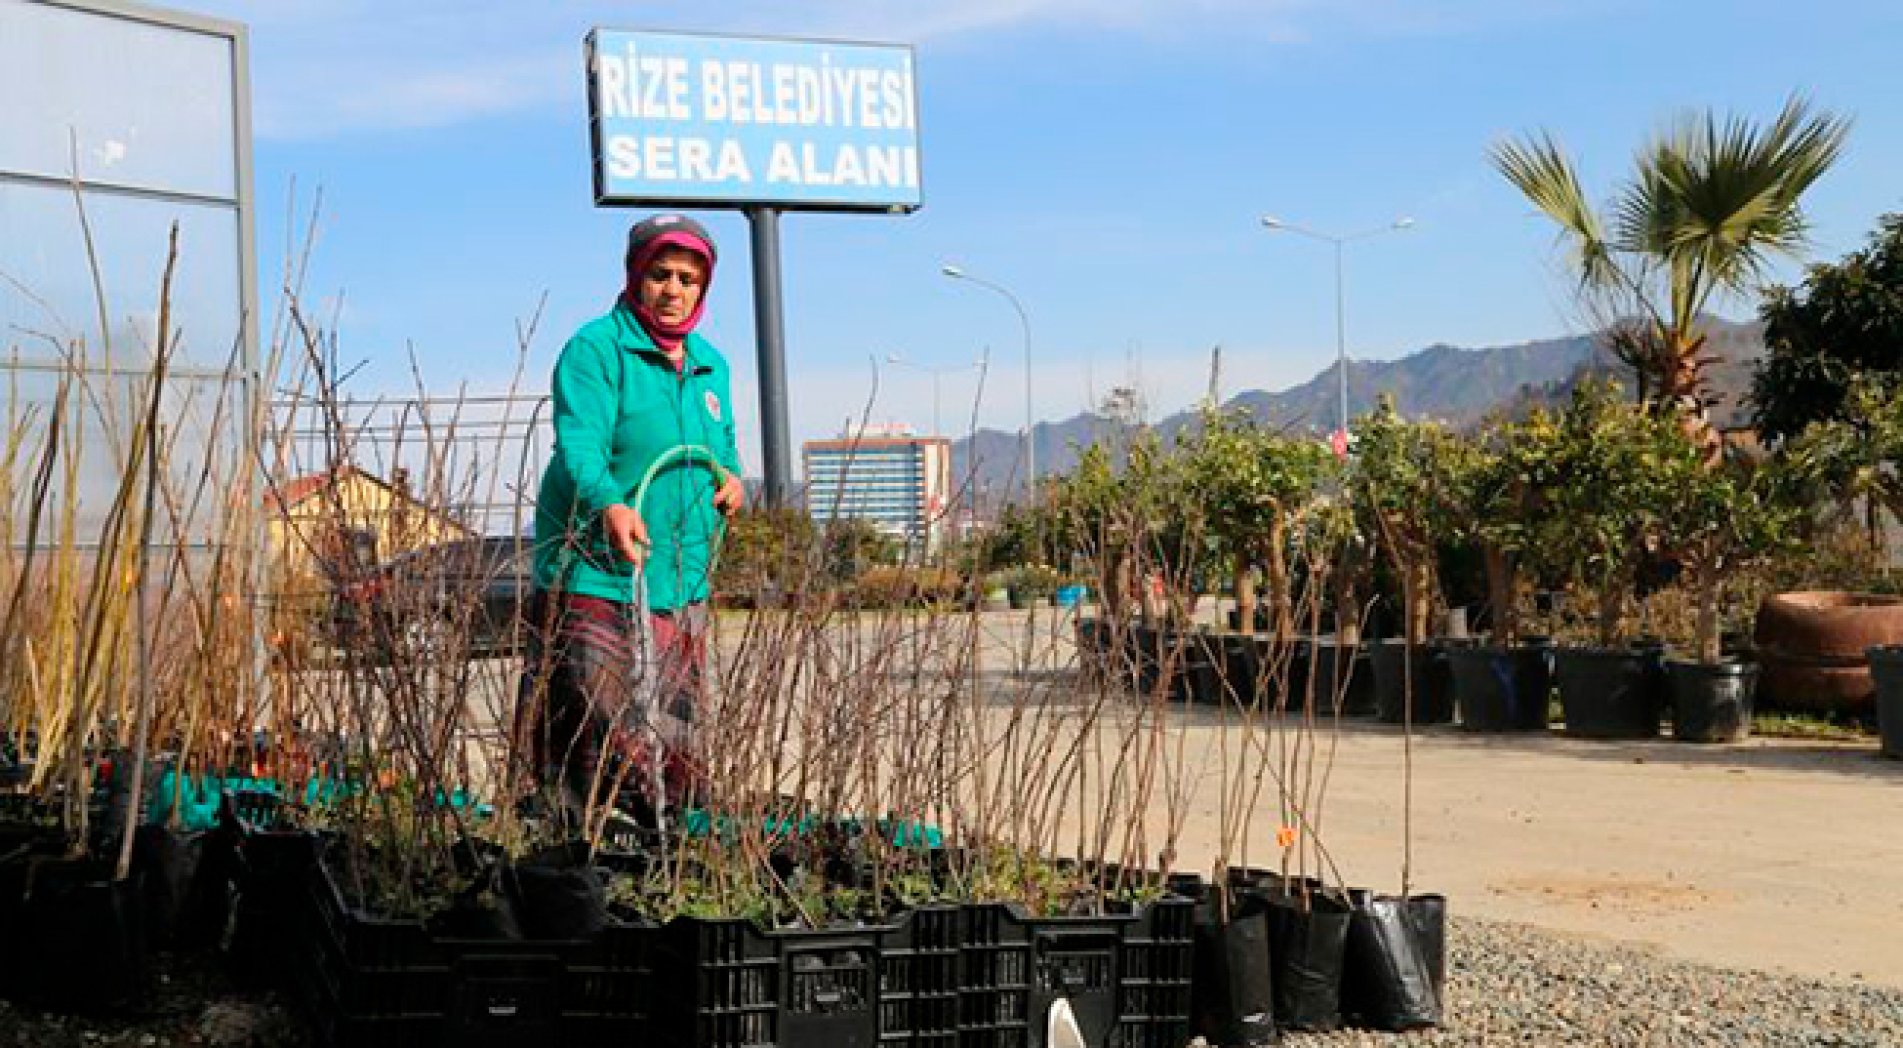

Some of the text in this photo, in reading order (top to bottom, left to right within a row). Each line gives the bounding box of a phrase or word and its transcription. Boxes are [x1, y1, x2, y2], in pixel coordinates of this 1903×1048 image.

[600, 41, 914, 129] RİZE BELEDİYESİ
[608, 136, 917, 187] SERA ALANI
